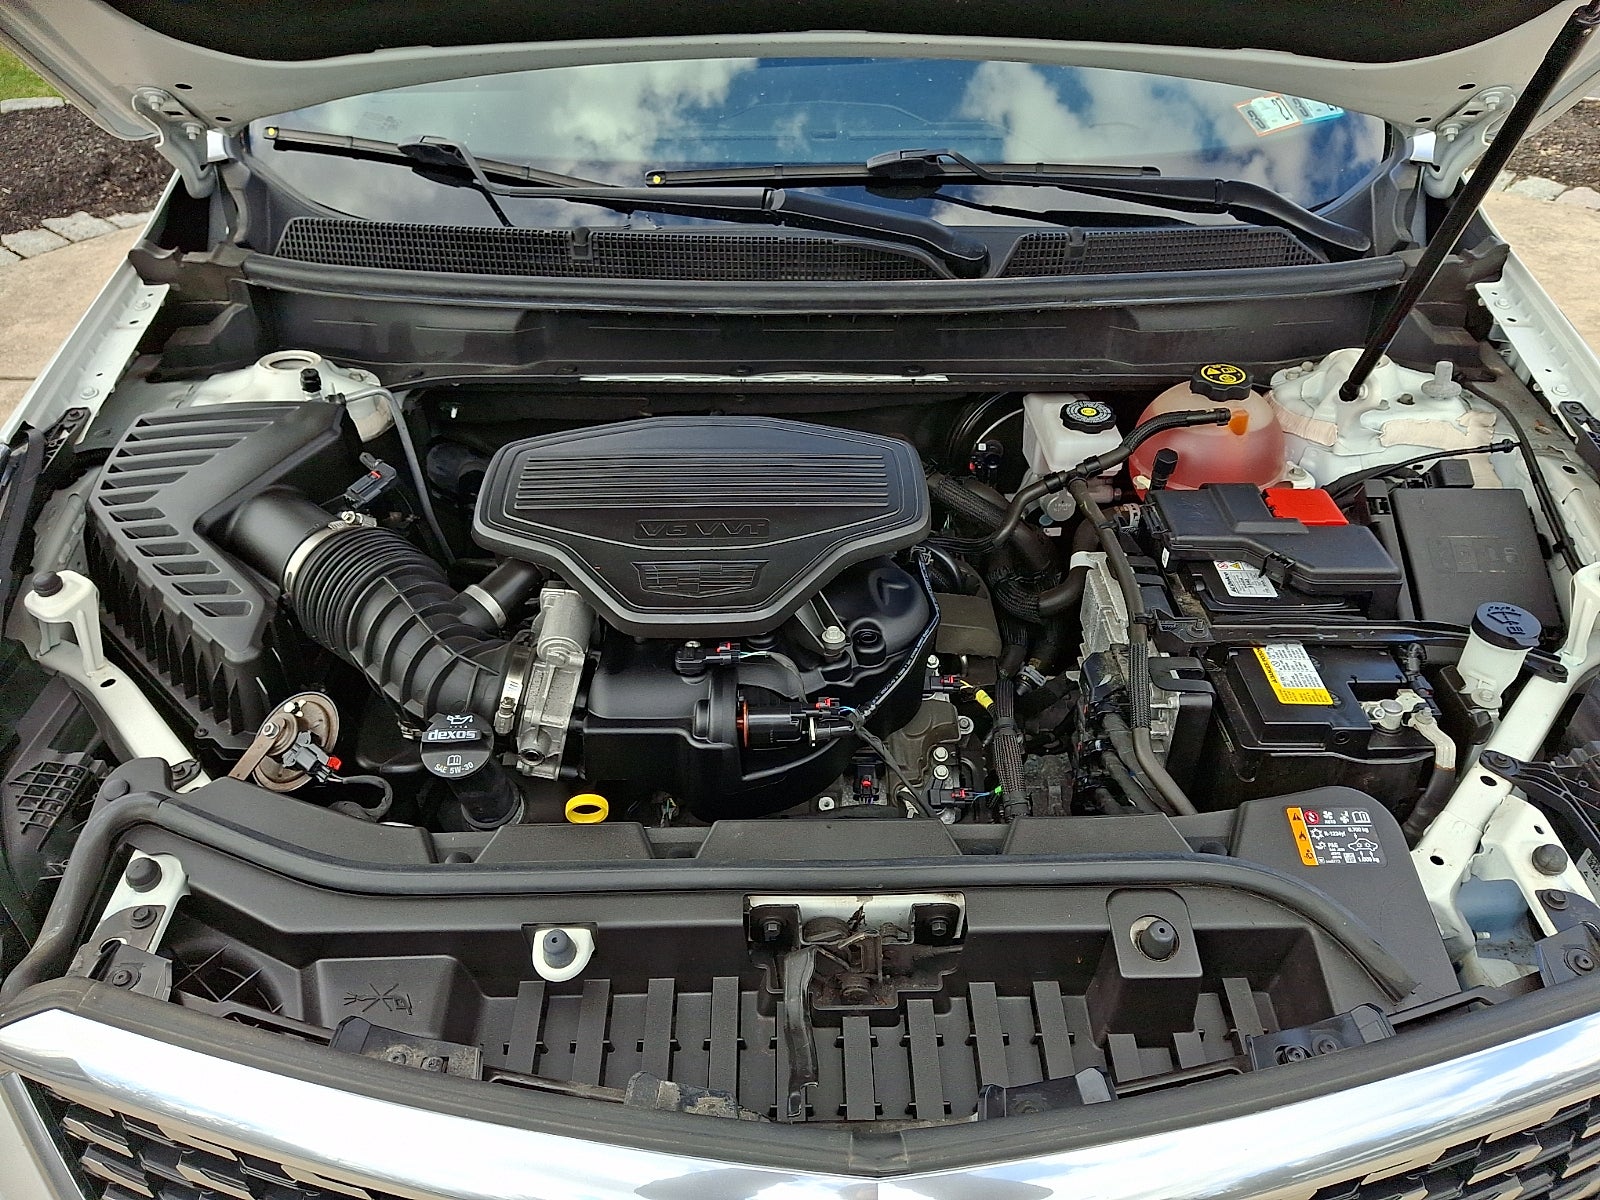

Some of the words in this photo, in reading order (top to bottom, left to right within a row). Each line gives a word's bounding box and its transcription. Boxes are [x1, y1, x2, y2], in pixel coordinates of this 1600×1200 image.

[640, 522, 688, 537] V6
[695, 521, 766, 536] VVT
[428, 729, 477, 740] dexos
[434, 763, 448, 774] SAE
[449, 762, 474, 774] 5W-30
